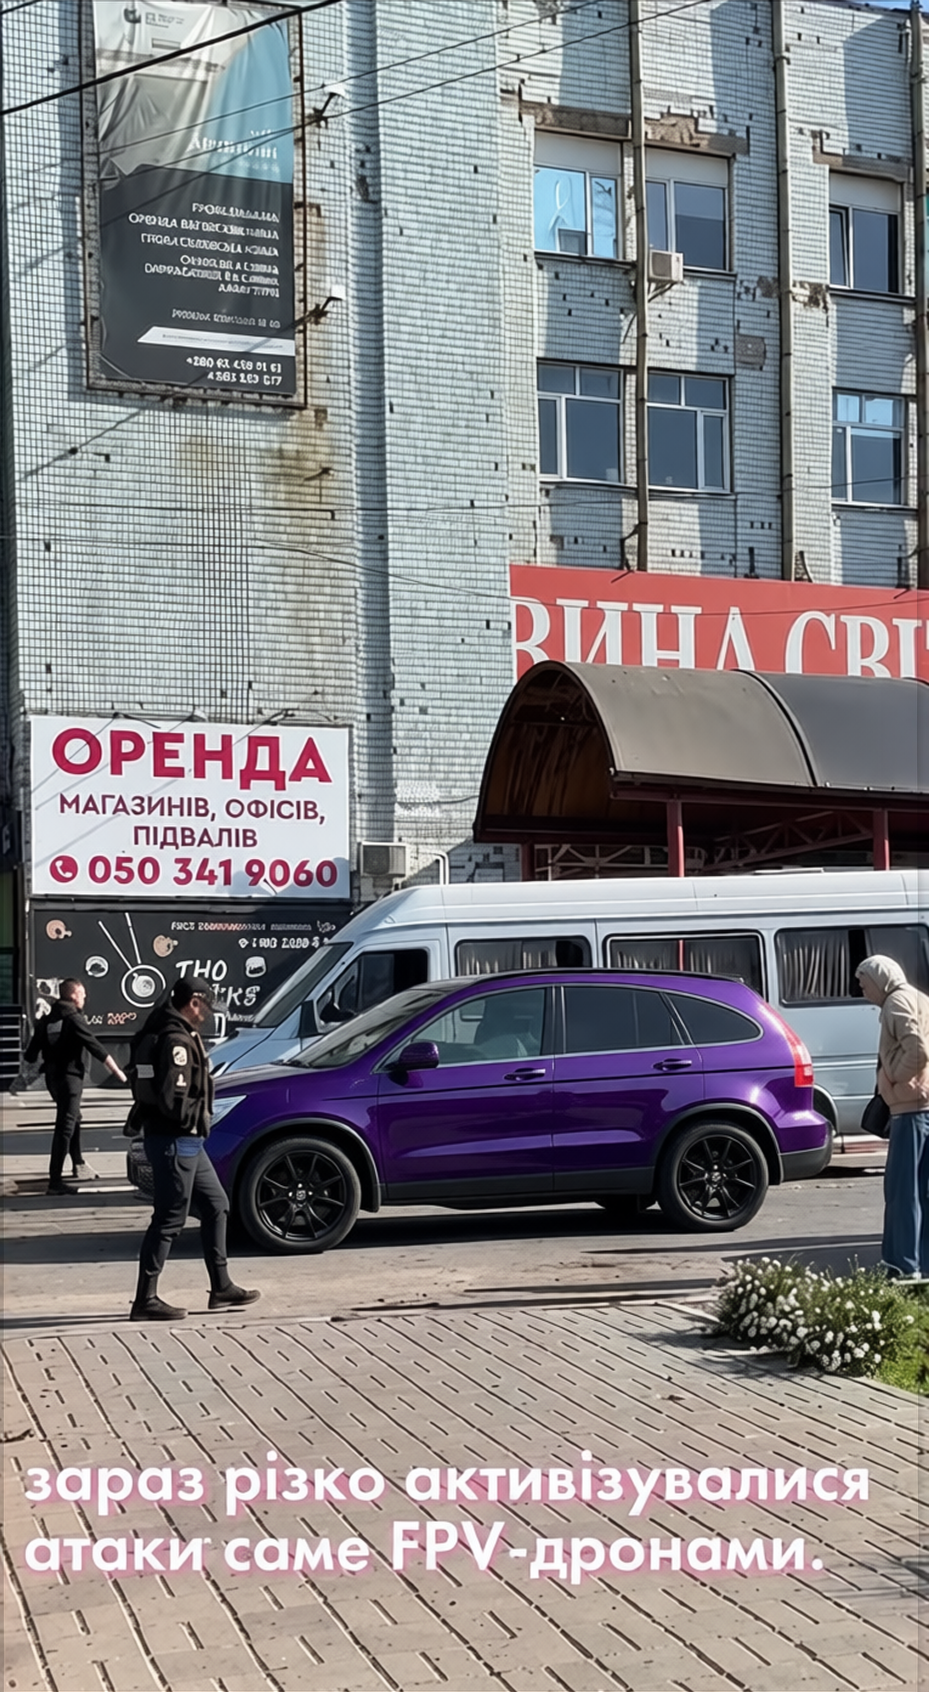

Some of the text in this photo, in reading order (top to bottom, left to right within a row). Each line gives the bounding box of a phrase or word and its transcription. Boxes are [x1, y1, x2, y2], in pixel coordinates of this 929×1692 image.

[786, 612, 929, 678] СВІ
[52, 728, 332, 791] ОРЕНДА
[59, 793, 327, 825] МАГАЗИНІВ, ОФІСІВ,
[133, 826, 259, 850] ПІДВАЛІВ
[88, 855, 338, 888] 050 341 9060
